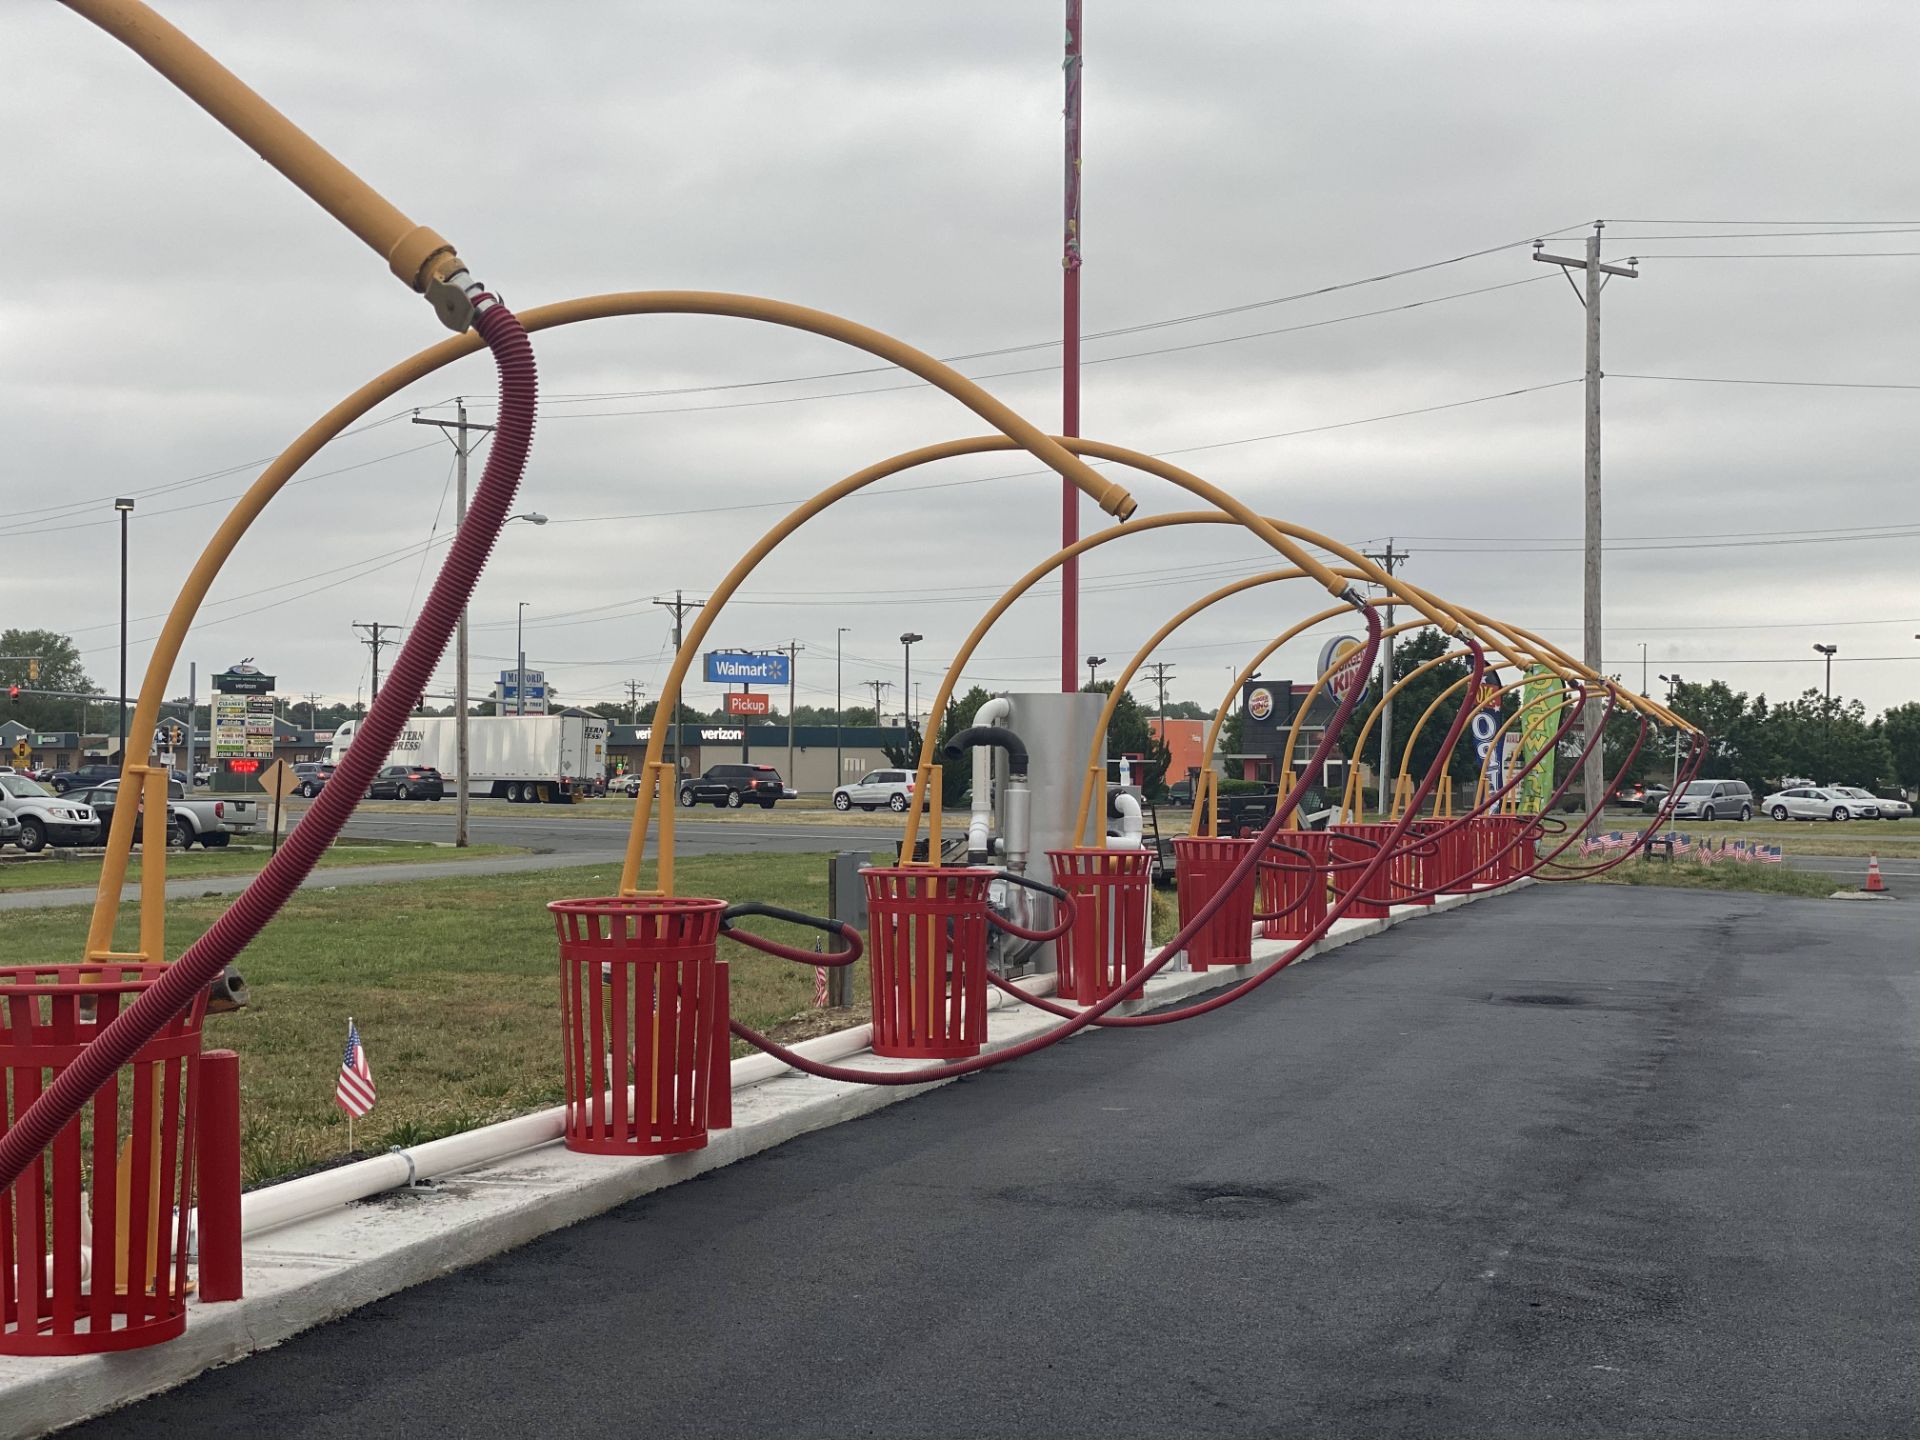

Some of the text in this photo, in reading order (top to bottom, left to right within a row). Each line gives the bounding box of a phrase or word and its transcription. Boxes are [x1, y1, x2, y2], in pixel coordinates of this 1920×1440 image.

[716, 661, 767, 676] Walmart
[507, 672, 542, 683] MIORD
[1333, 667, 1360, 694] KIN
[732, 698, 765, 714] Pickup
[701, 727, 742, 740] verizon
